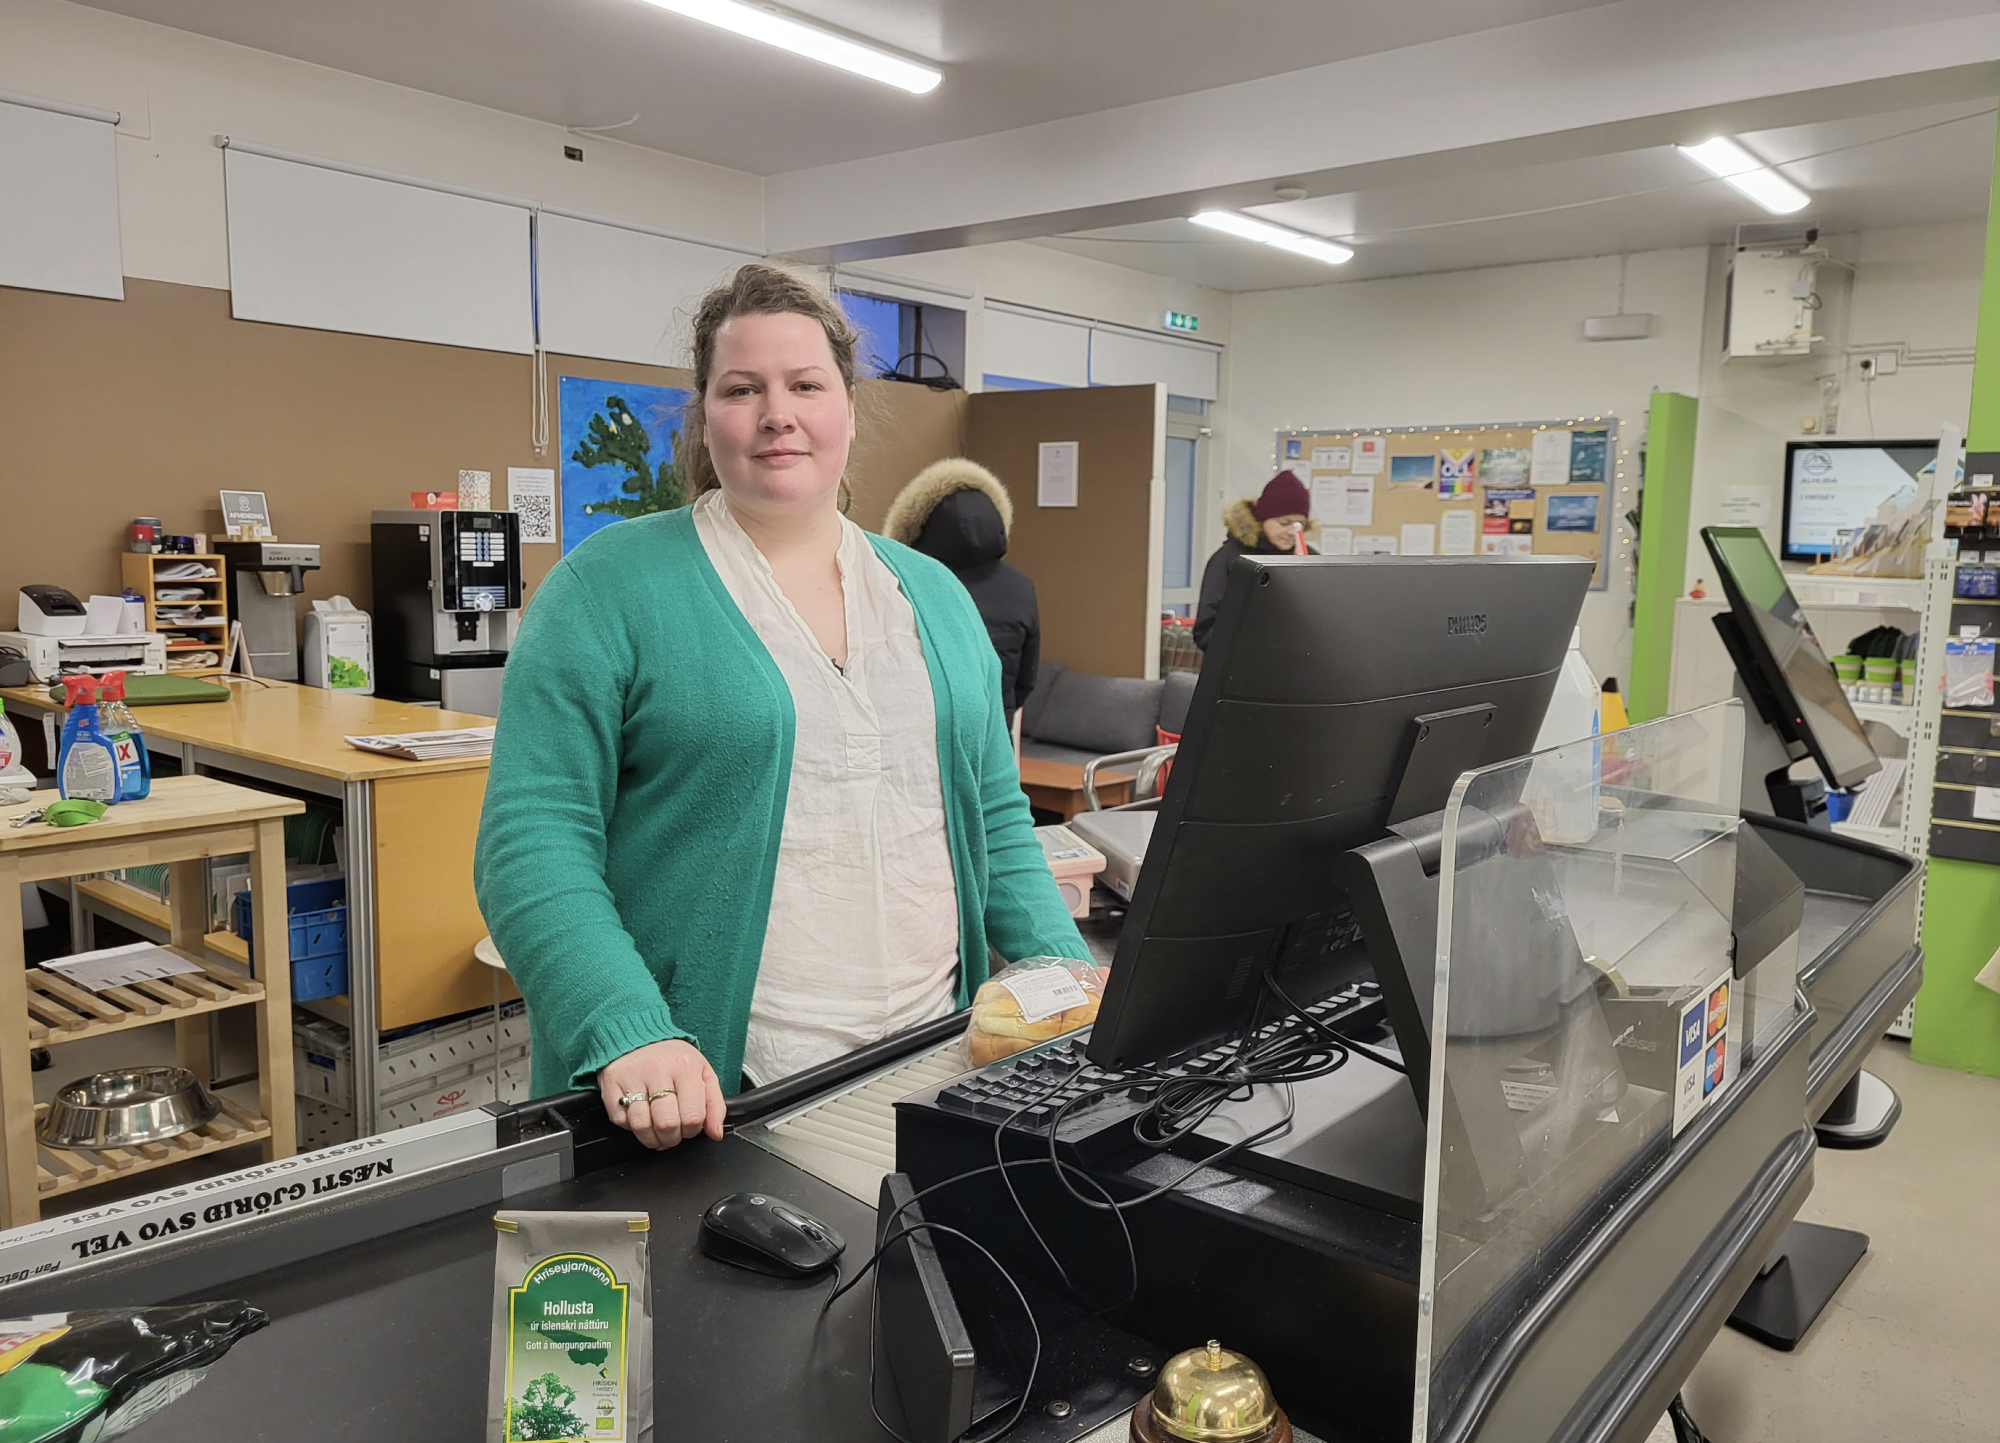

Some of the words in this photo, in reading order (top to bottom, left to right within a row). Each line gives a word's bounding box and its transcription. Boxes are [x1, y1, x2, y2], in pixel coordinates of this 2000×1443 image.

[1441, 463, 1473, 477] OLL
[1685, 1019, 1701, 1047] VISA
[1684, 1073, 1696, 1095] VISA
[302, 1138, 387, 1164] NÆSTI
[312, 1158, 394, 1195] NÆSTI
[130, 1189, 189, 1208] SVO
[203, 1182, 306, 1224] GJÖRIÐ
[63, 1207, 125, 1225] VEL
[138, 1211, 197, 1241] SVO
[71, 1230, 133, 1259] VEL
[543, 1300, 594, 1316] Hollusta
[530, 1320, 540, 1331] úr
[541, 1319, 577, 1331] íslenskri
[578, 1319, 609, 1330] náttúru
[525, 1340, 542, 1350] Gott
[543, 1340, 548, 1350] á
[550, 1339, 612, 1351] morgungrautinn
